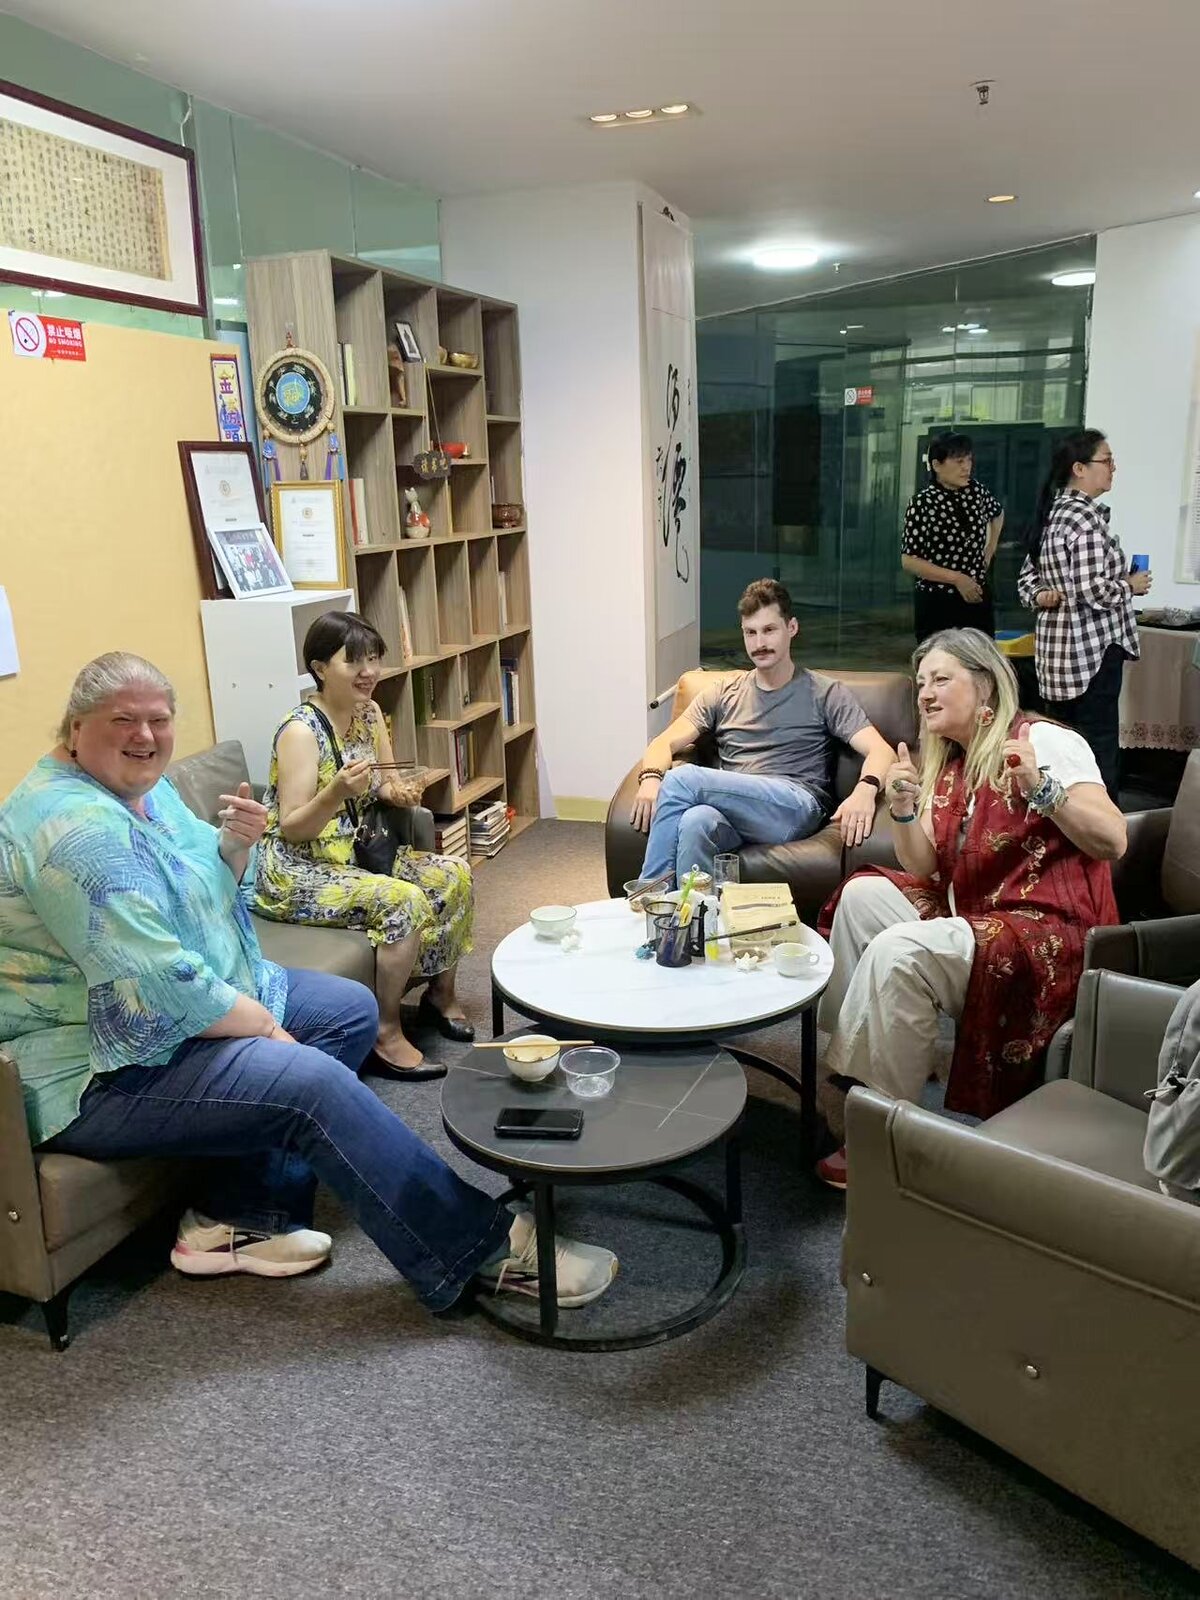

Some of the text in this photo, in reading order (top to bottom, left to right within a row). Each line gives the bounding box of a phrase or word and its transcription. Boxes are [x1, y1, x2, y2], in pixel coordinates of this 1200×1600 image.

[47, 324, 81, 340] 禁止吸烟
[58, 339, 82, 347] SMOKING
